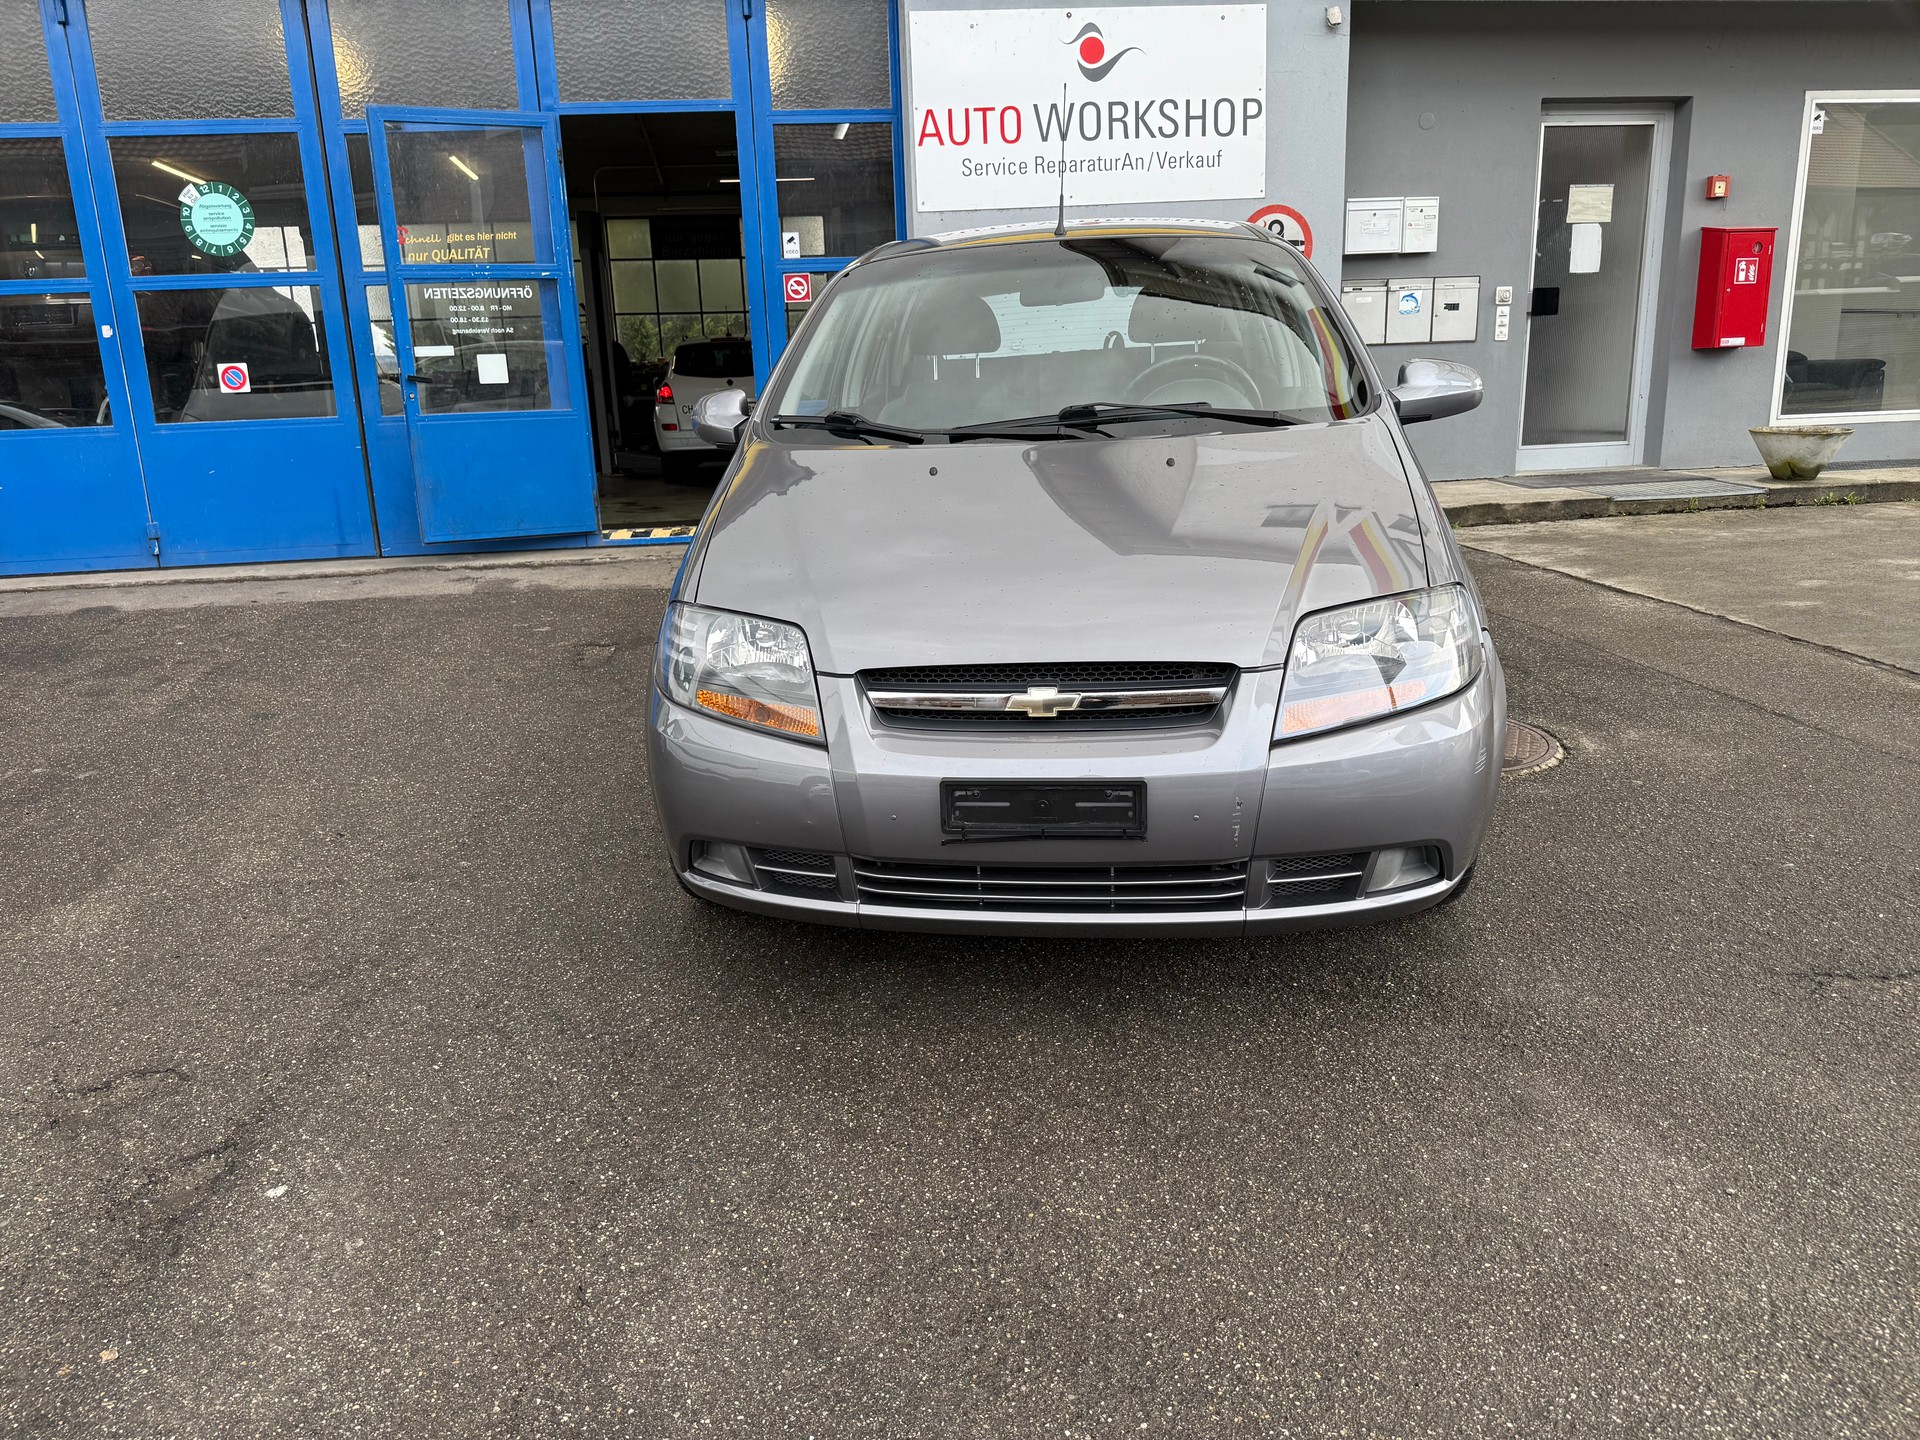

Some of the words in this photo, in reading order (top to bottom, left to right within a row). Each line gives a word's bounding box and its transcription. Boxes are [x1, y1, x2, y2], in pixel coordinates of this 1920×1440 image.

[917, 105, 1022, 147] AUTO
[1032, 98, 1263, 142] WORKSHOP
[961, 157, 1028, 177] Service
[200, 185, 210, 194] 12
[218, 185, 223, 193] 1
[232, 192, 240, 201] 2
[182, 207, 190, 217] 10
[239, 236, 248, 245] 5
[447, 232, 463, 243] gibt
[465, 233, 475, 242] es
[477, 231, 494, 241] hier
[495, 231, 517, 240] nicht
[195, 238, 203, 246] 8
[226, 245, 234, 253] 6
[408, 250, 429, 262] nur
[431, 245, 491, 263] QUALITÄT
[681, 404, 694, 415] CH
